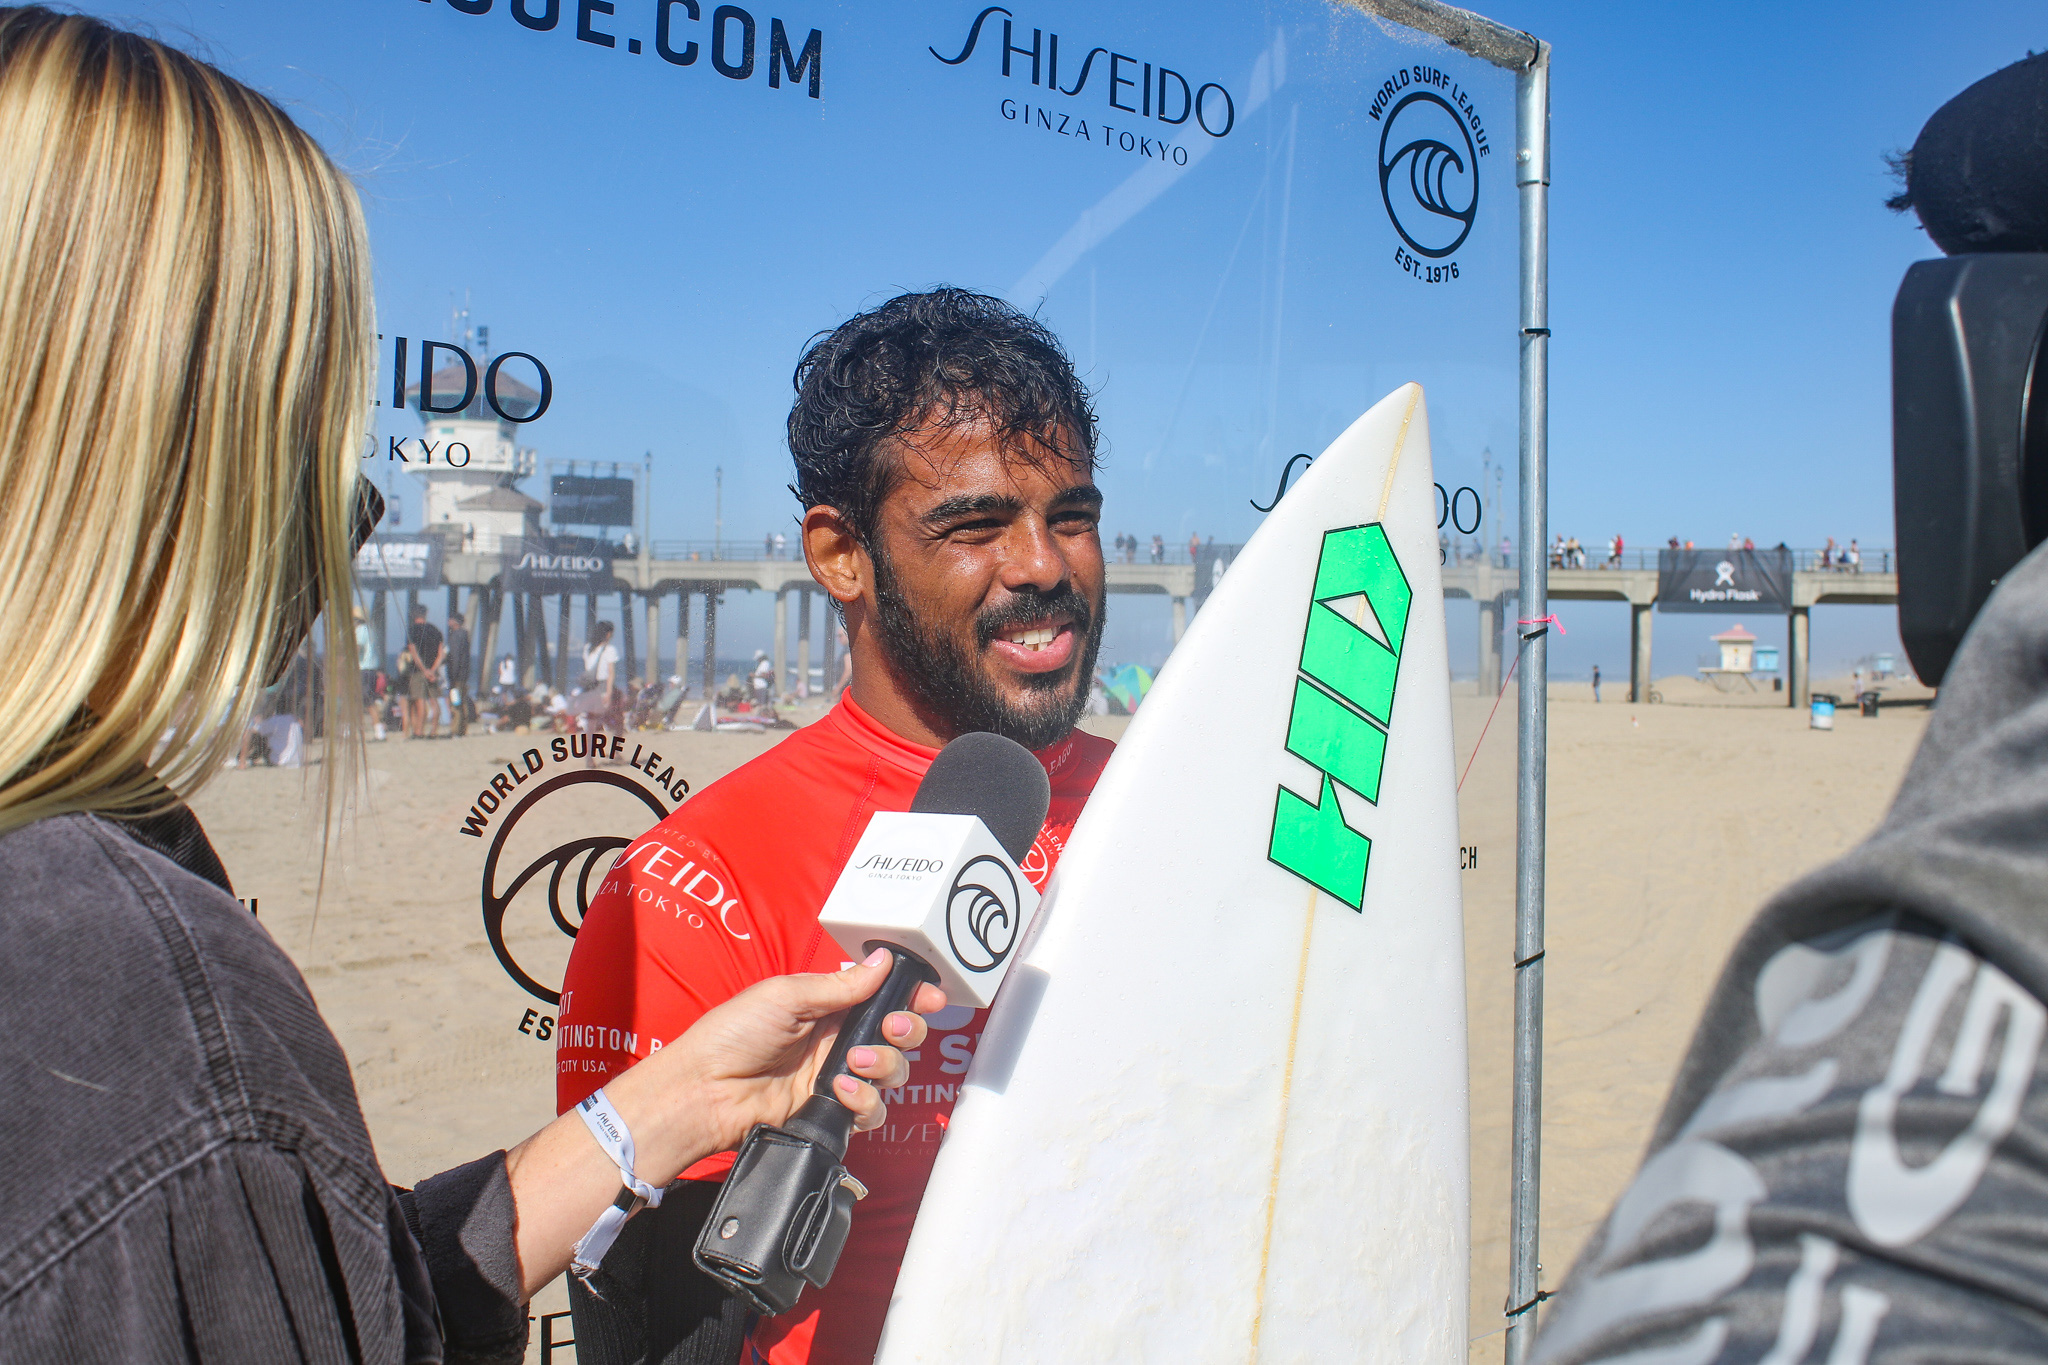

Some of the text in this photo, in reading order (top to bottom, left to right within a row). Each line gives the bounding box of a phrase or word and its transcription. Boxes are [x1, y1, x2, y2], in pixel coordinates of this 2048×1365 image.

[928, 6, 1235, 138] SHISEIDO
[1368, 65, 1490, 158] WORLD SURF LEAGUE
[1000, 99, 1188, 166] GINZA TOKYO
[1394, 246, 1459, 284] EST. 1976
[373, 333, 552, 424] IDO
[511, 552, 604, 572] SHISEIDO
[1689, 588, 1725, 604] Hydro
[460, 748, 545, 838] WORLD
[551, 733, 626, 762] SURF
[855, 854, 944, 874] SHISEIDO
[626, 883, 704, 929] TOKYO
[557, 1024, 638, 1055] NTINGTON
[561, 1060, 578, 1073] CITY
[582, 1059, 607, 1073] USA
[595, 1112, 622, 1142] SHISEIDO
